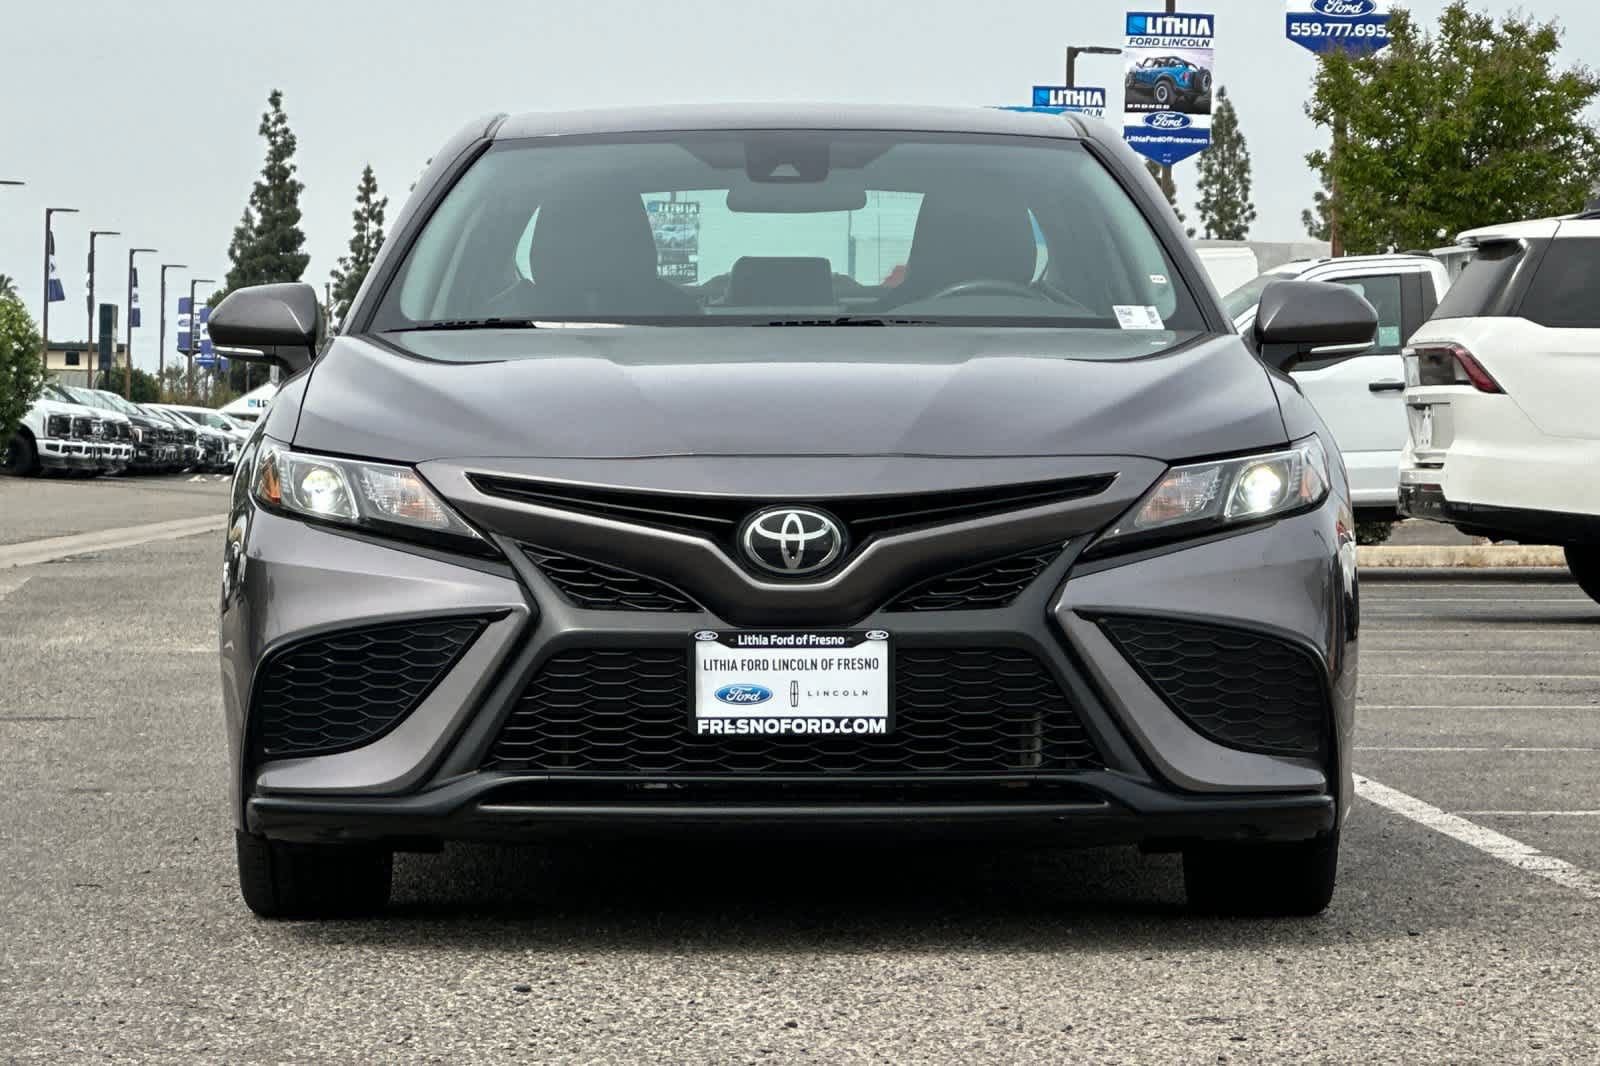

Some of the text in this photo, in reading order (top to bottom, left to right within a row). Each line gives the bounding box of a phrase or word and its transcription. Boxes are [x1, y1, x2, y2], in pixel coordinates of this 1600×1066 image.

[1146, 16, 1211, 35] LITHIA
[1129, 37, 1210, 47] FORD LINCOLN
[1049, 89, 1103, 106] LITHIA
[1152, 113, 1183, 127] Ford
[738, 634, 845, 646] Lithia Ford of Fresno
[703, 657, 879, 672] LITHIA FORD LINCOLN OF FRESNO
[725, 686, 761, 702] Ford
[697, 718, 886, 735] FRESNOFORD.COM
